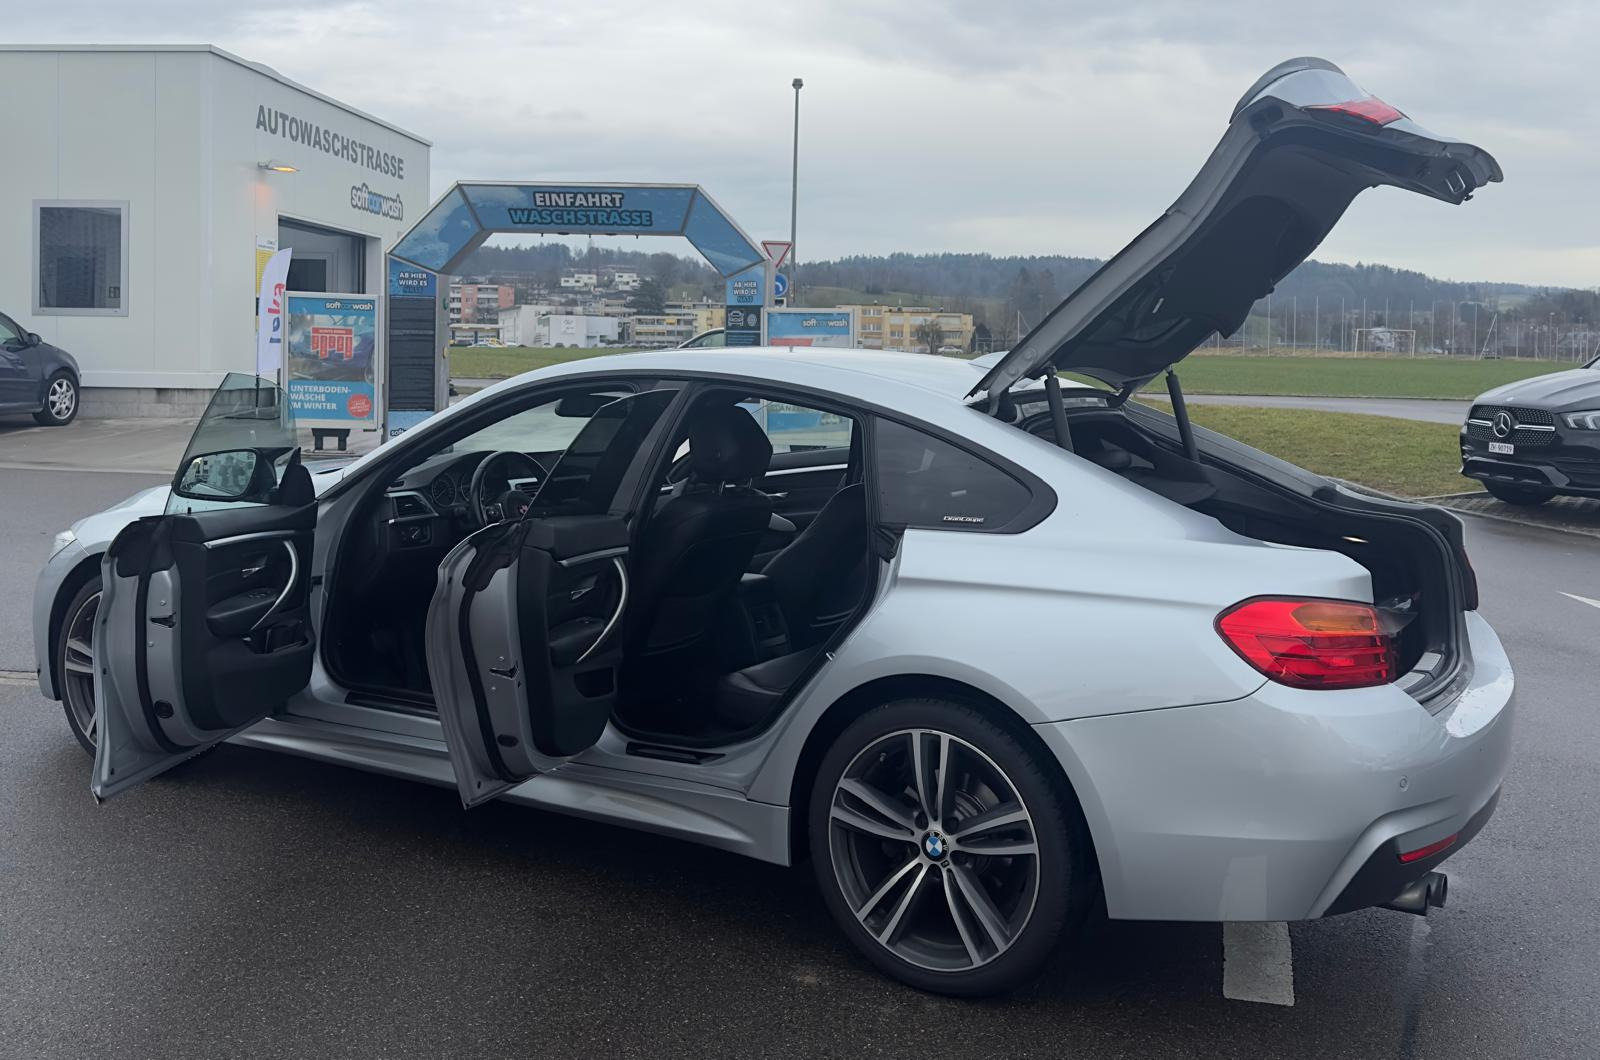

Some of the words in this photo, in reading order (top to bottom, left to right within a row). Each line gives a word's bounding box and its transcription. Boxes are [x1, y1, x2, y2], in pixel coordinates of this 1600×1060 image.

[256, 104, 405, 180] AUTOWASCHSTRASSE
[534, 192, 624, 208] EINFAHRT
[509, 208, 652, 226] WASCHSTRASSE
[290, 384, 351, 394] UNTERBODEN-
[303, 401, 337, 410] WINTER
